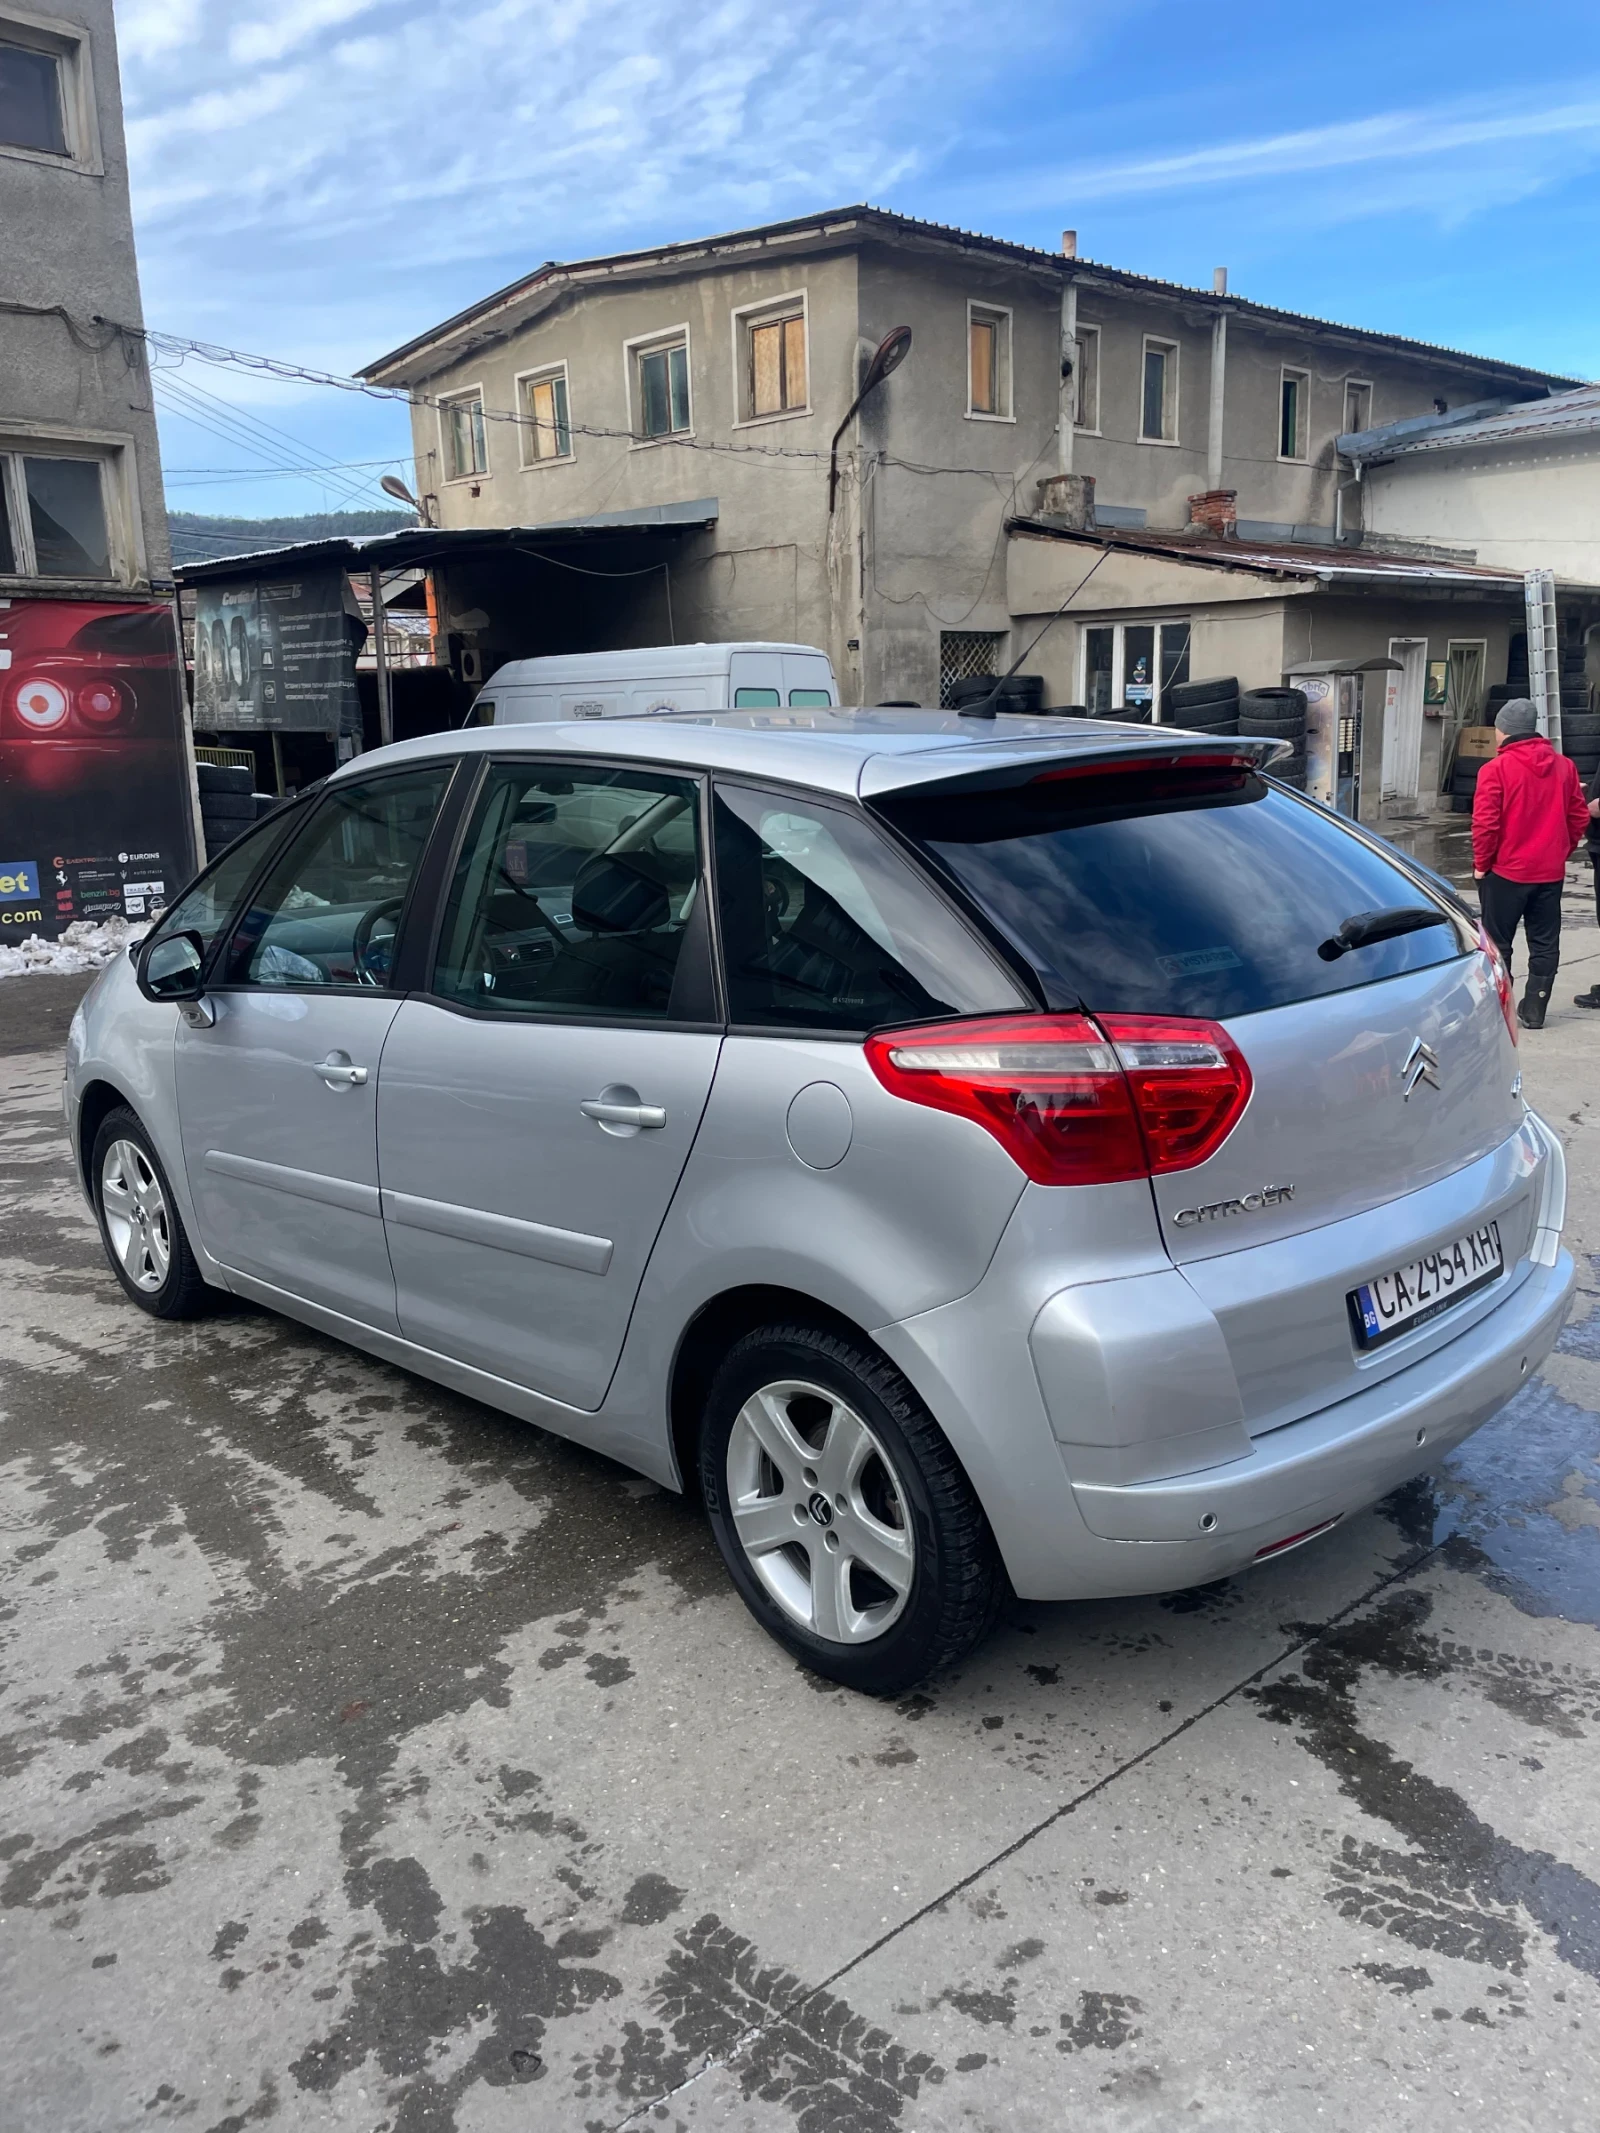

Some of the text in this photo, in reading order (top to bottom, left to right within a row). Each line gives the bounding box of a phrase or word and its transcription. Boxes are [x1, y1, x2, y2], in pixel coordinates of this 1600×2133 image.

[129, 852, 160, 861] EUROINS
[80, 889, 121, 899] benzin.bg
[1173, 1184, 1295, 1228] CITROËN
[1373, 1271, 1413, 1319] CA
[1417, 1242, 1468, 1302] 2954
[1364, 1310, 1376, 1329] BG
